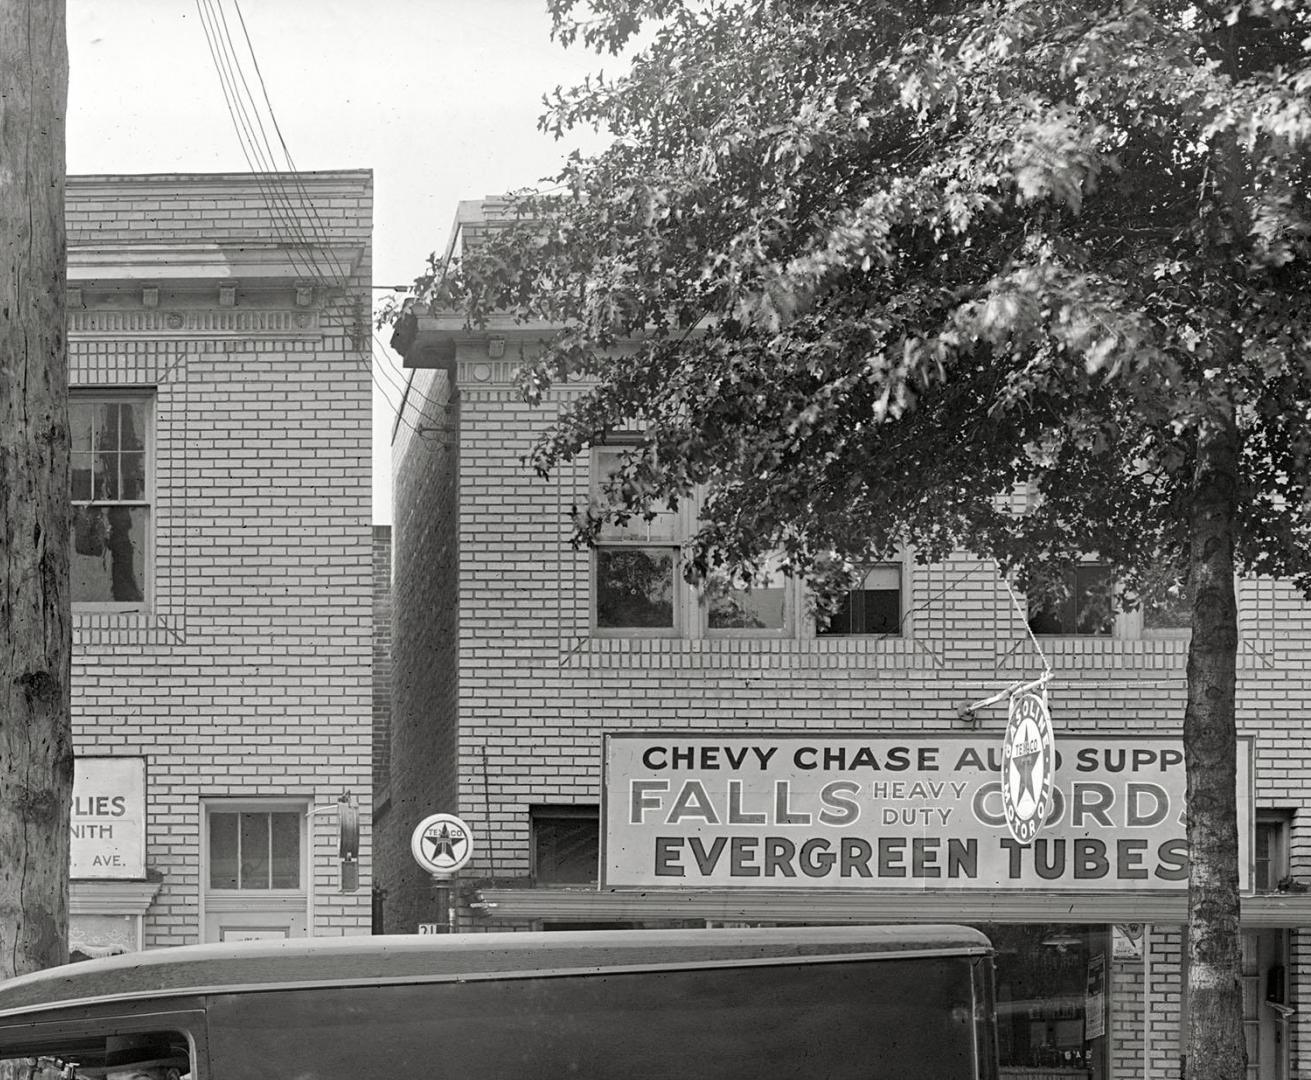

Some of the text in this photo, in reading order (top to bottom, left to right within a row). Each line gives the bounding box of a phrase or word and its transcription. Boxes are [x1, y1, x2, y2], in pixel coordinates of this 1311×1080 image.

[642, 746, 778, 771] CHEVY
[793, 746, 940, 772] CHASE
[1076, 748, 1184, 773] SUPP
[873, 780, 968, 800] HEAVY
[629, 778, 862, 828] FALLS
[881, 806, 955, 826] DUTY
[92, 855, 126, 867] AVE.
[654, 836, 1188, 881] EVERGREEN TUBES
